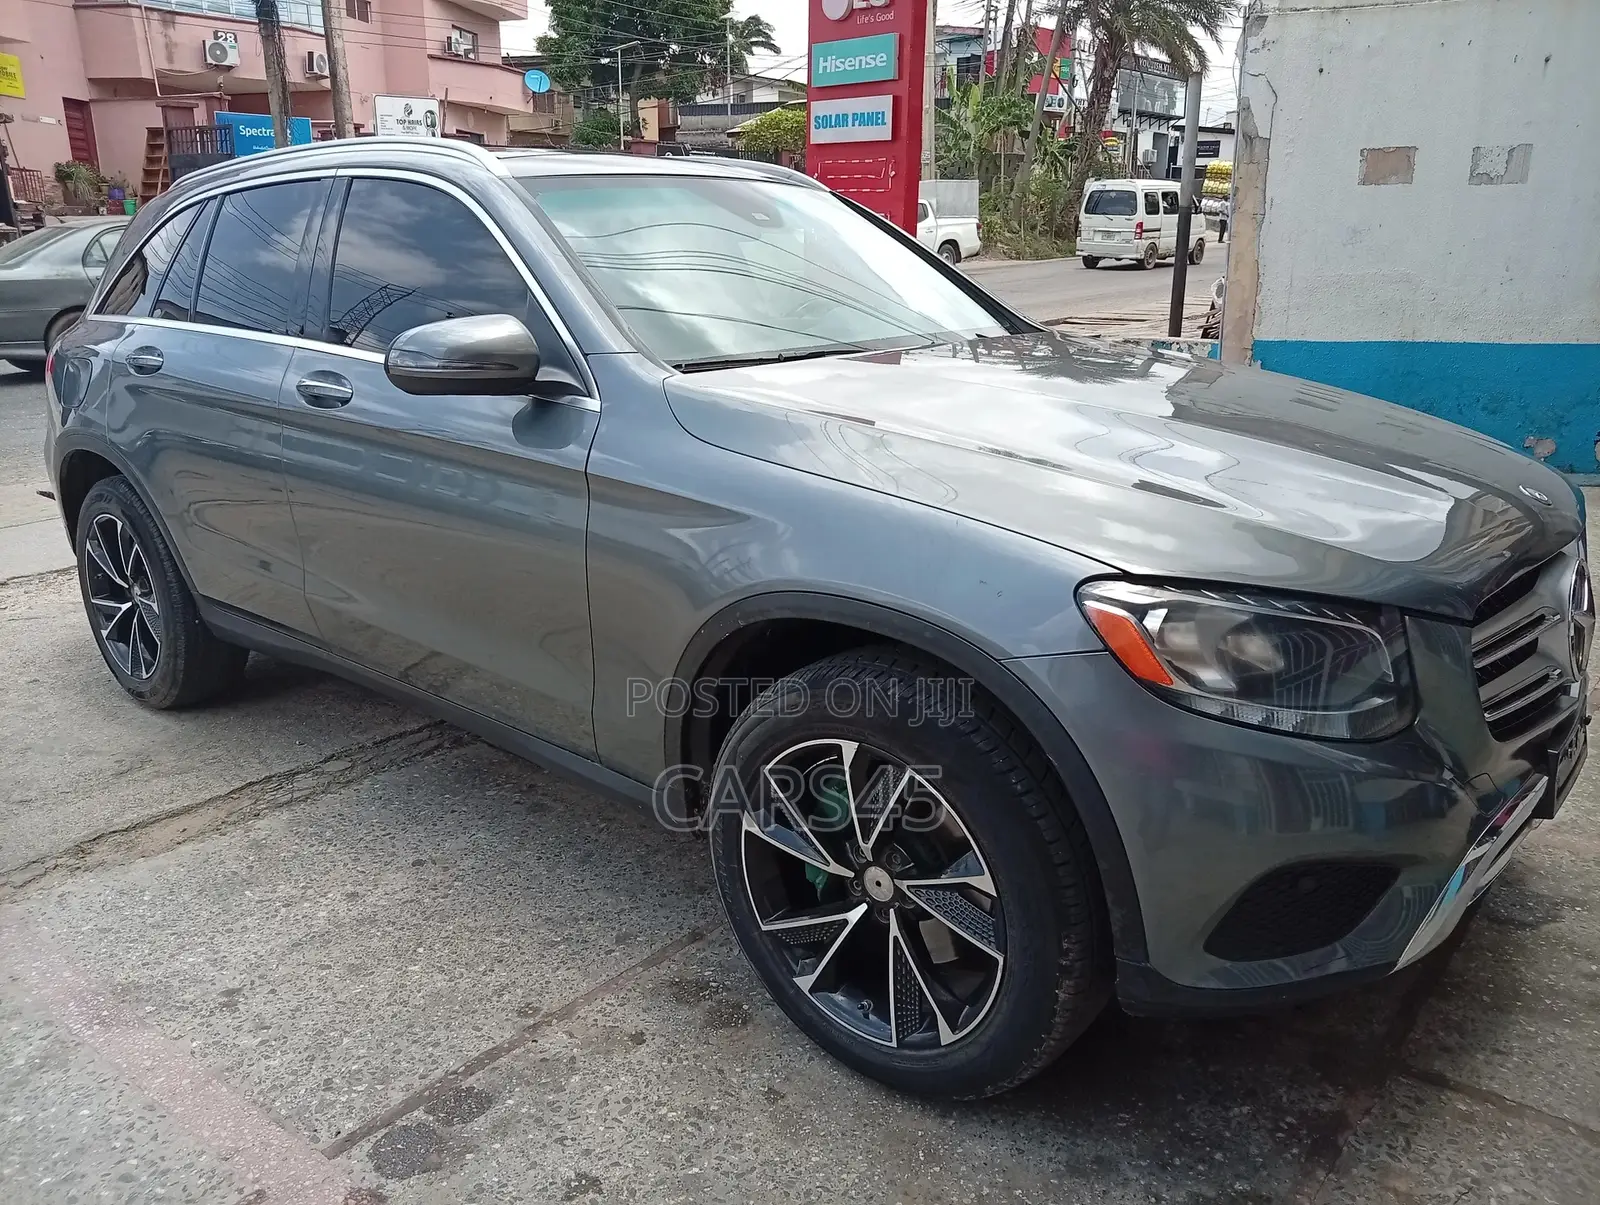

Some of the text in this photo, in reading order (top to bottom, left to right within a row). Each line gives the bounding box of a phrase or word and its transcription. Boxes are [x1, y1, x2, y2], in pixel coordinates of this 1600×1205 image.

[857, 11, 894, 24] Life's Good
[217, 32, 235, 43] 28
[818, 52, 888, 74] Hisense
[396, 118, 407, 126] TOP
[814, 111, 887, 130] SOLAR PANEL
